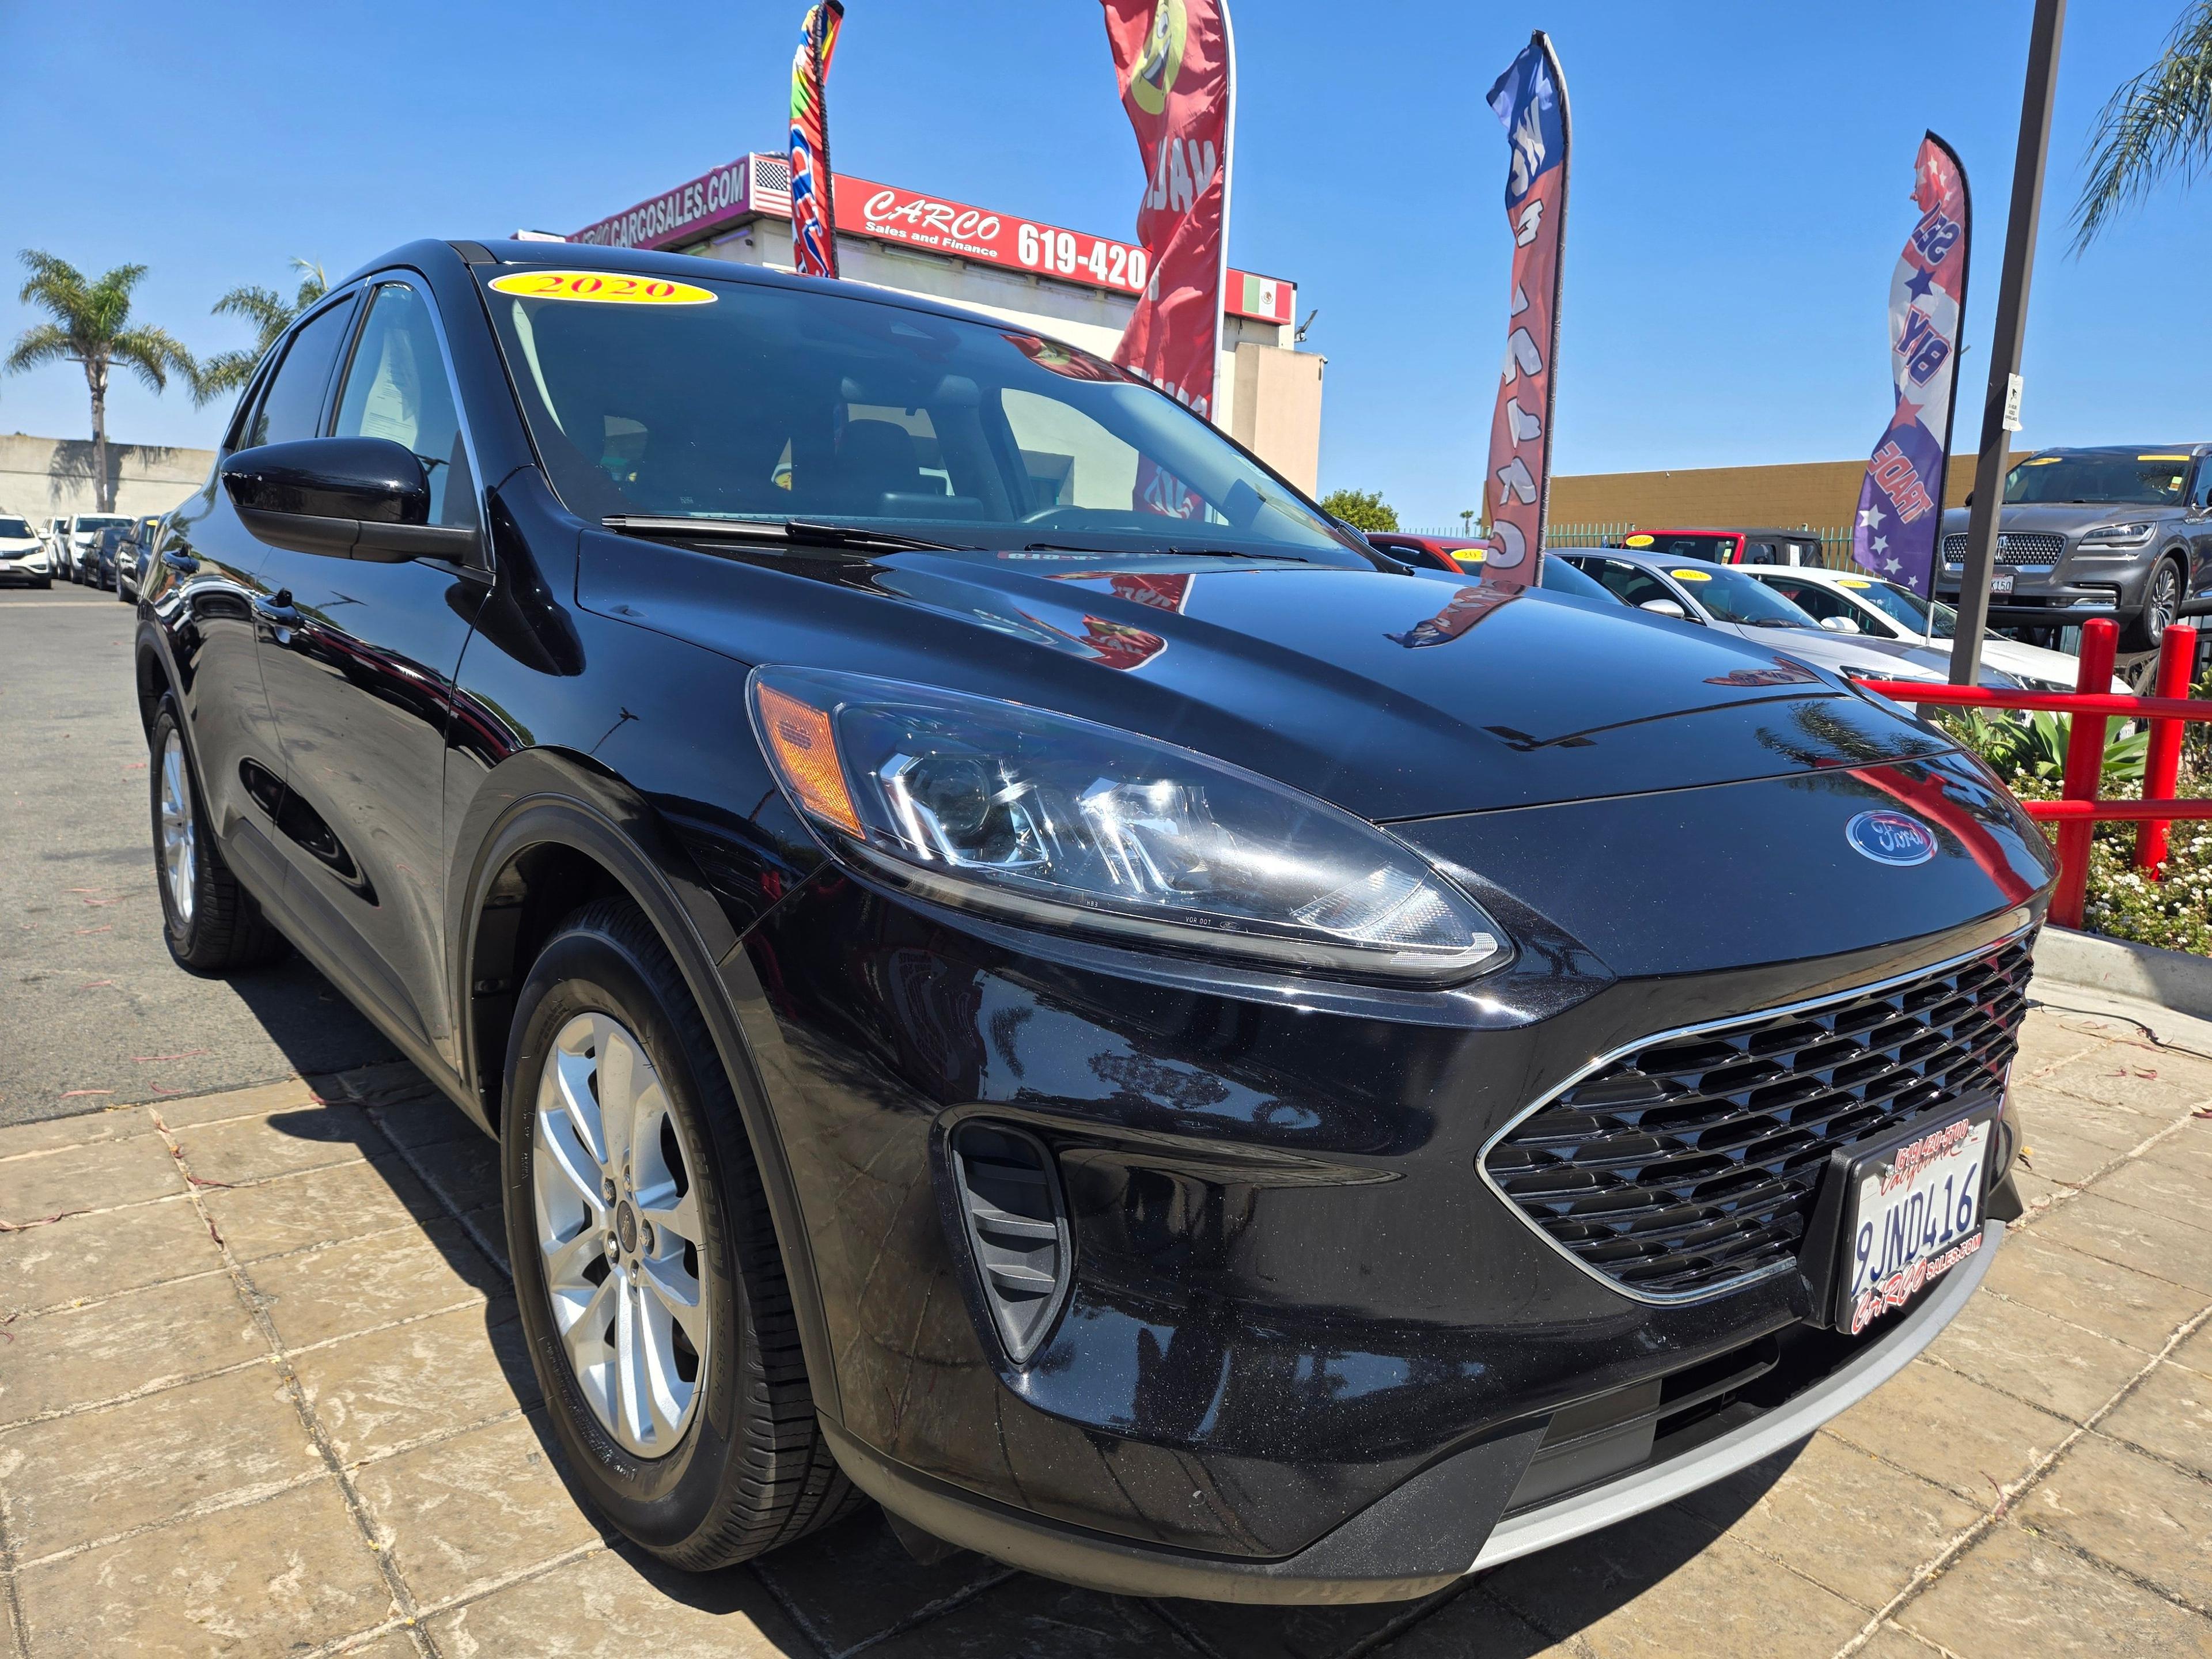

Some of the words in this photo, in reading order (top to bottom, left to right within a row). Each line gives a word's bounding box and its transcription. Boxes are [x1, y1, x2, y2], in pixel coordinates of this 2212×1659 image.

[611, 162, 745, 247] CARCOSALES.COM
[863, 190, 1001, 240] CARCO
[865, 221, 907, 238] Sales
[911, 232, 939, 245] and
[942, 237, 998, 257] Finance
[531, 276, 675, 297] 2020
[1871, 820, 1923, 851] Ford
[1086, 900, 1098, 908] HB3
[1894, 1138, 1923, 1172] (619)
[1922, 1118, 1969, 1157] 420-5700
[1851, 1162, 1977, 1297] 9JND416
